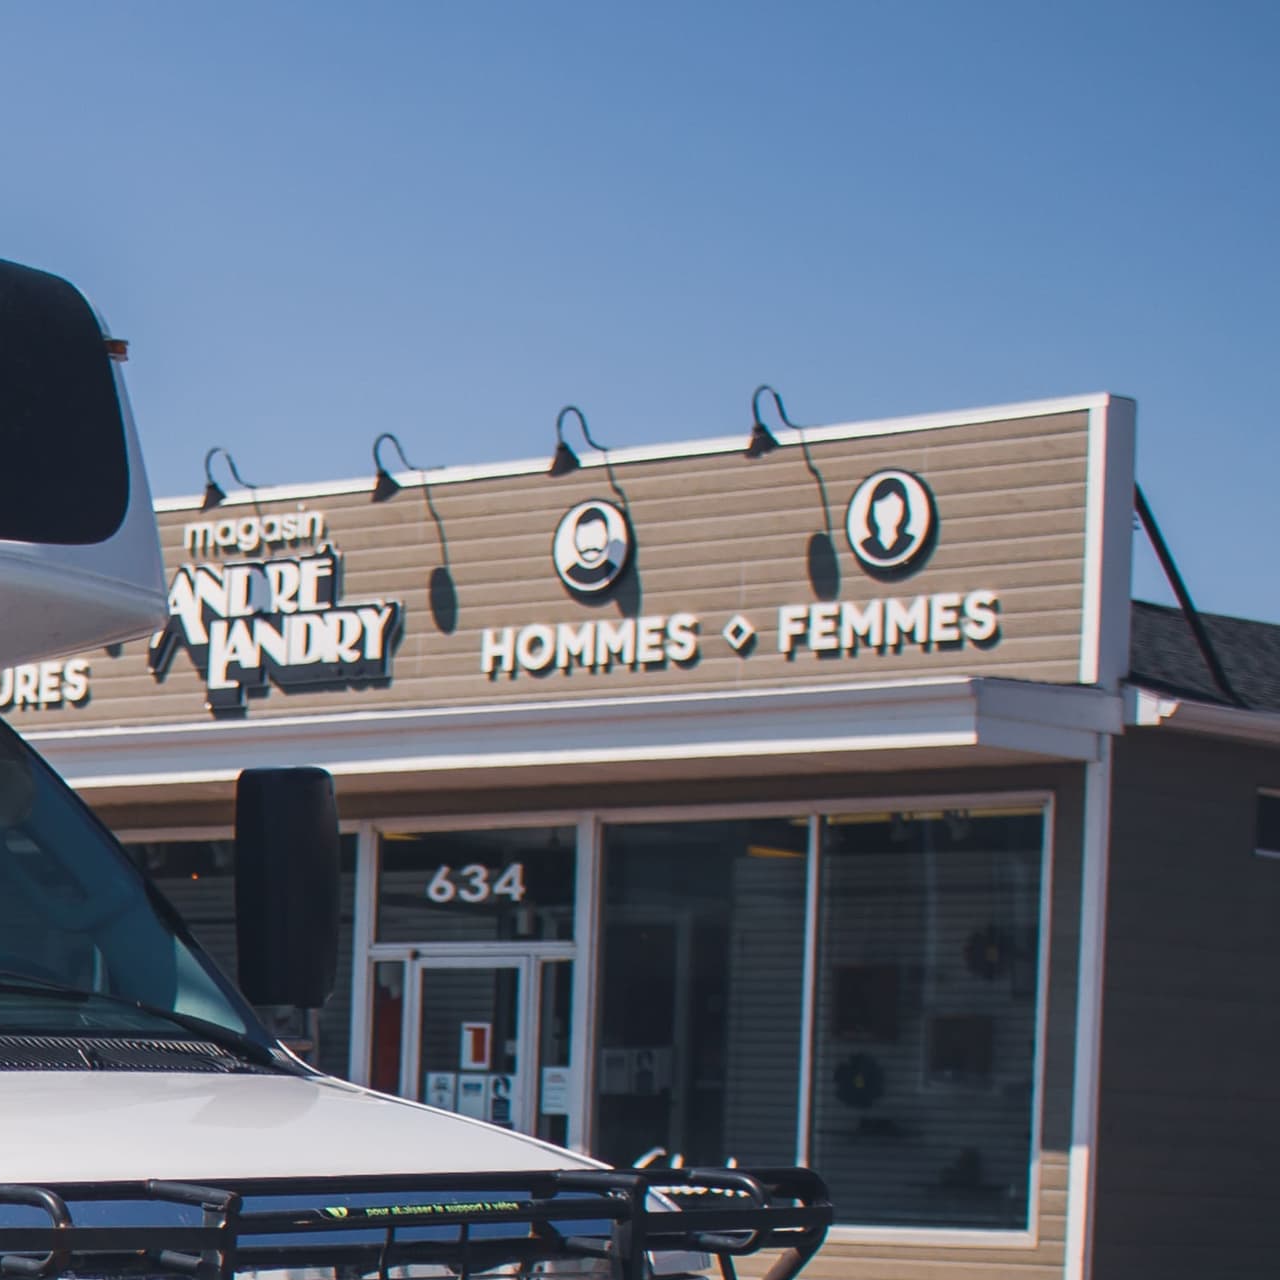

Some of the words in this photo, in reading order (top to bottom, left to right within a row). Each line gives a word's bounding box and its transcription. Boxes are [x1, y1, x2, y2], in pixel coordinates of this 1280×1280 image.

[183, 502, 324, 552] magasin
[149, 541, 336, 649] ANDRÉ
[481, 612, 700, 674] HOMMES
[777, 588, 1000, 653] FEMMES
[207, 600, 394, 690] LANDRY
[426, 863, 526, 902] 634
